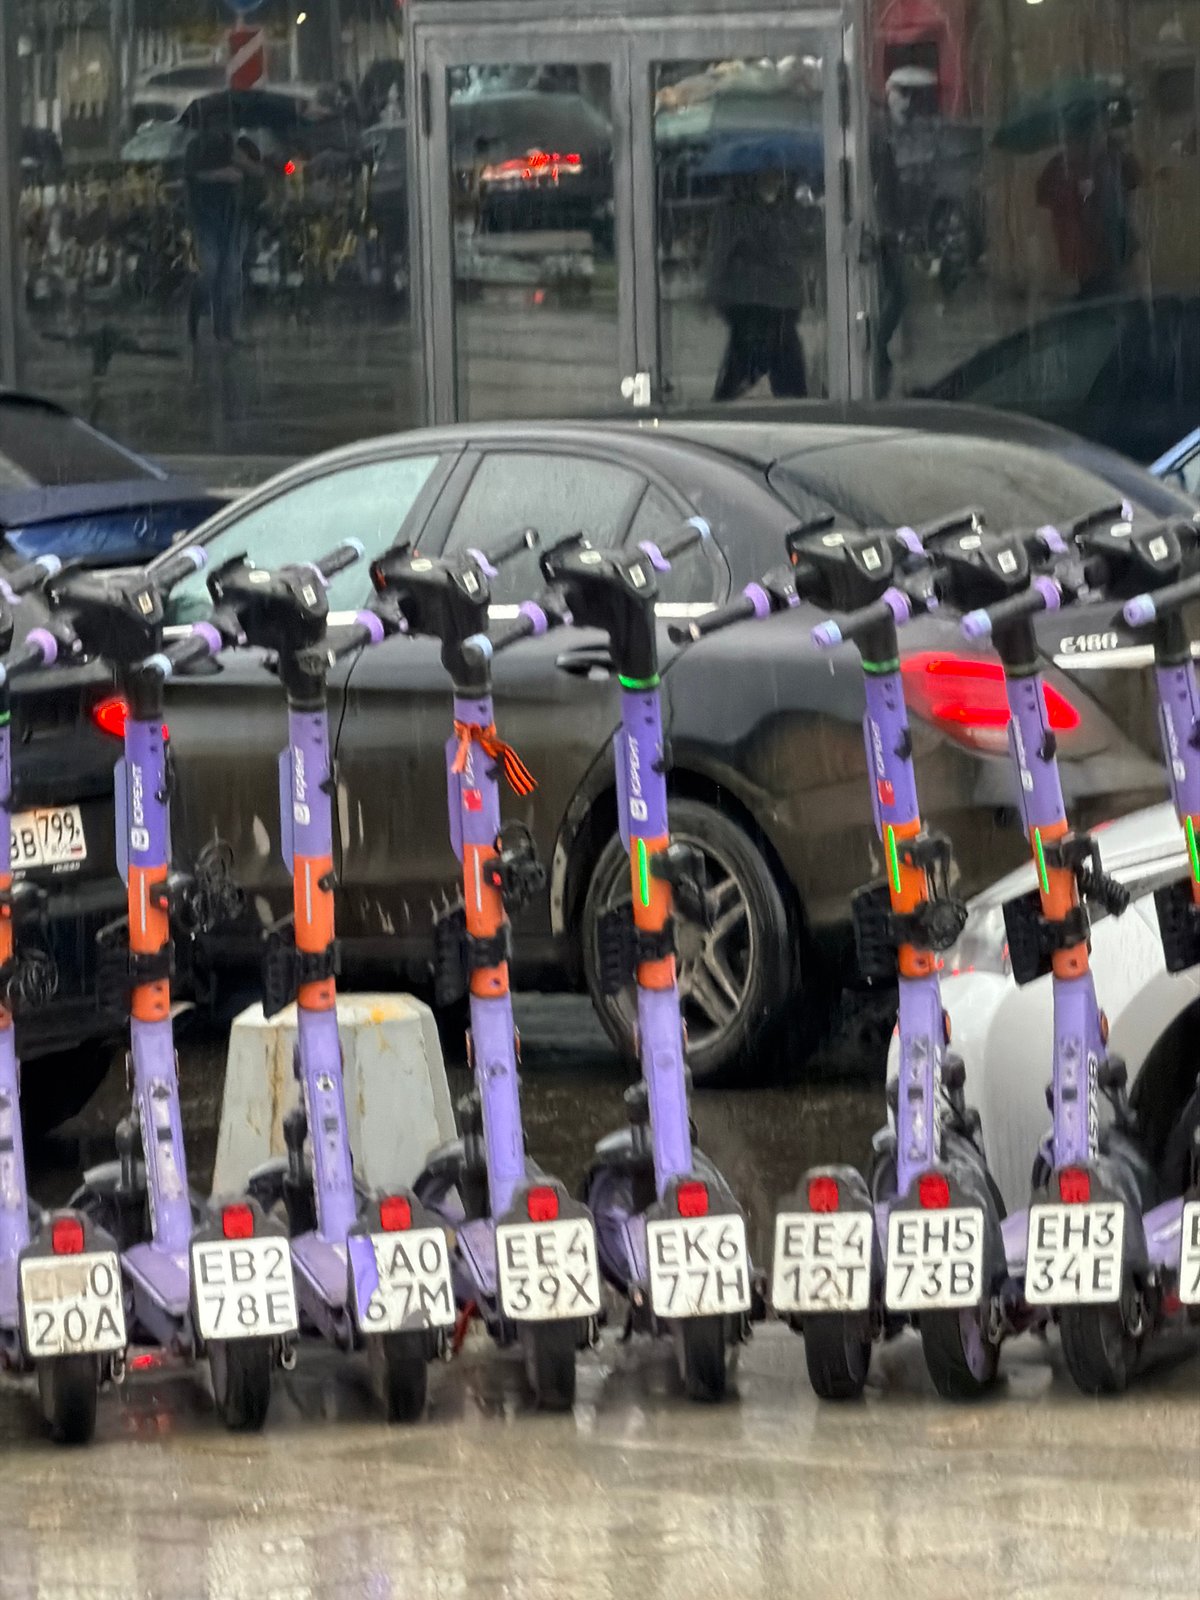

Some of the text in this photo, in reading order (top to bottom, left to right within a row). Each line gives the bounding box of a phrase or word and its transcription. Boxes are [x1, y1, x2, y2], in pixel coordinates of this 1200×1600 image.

[37, 811, 75, 846] 799
[504, 1227, 589, 1269] EE4
[655, 1223, 739, 1265] EK6
[783, 1220, 864, 1258] EE4
[896, 1215, 976, 1256] EH5
[1036, 1211, 1115, 1251] EH3
[199, 1247, 286, 1286] EB2
[376, 1239, 442, 1282] A0
[892, 1260, 975, 1297] 73B
[1032, 1254, 1114, 1294] 34E
[507, 1269, 597, 1311] 39X
[657, 1265, 745, 1310] 77H
[782, 1261, 866, 1301] 12T
[32, 1304, 122, 1347] 20A
[204, 1291, 294, 1330] 78E
